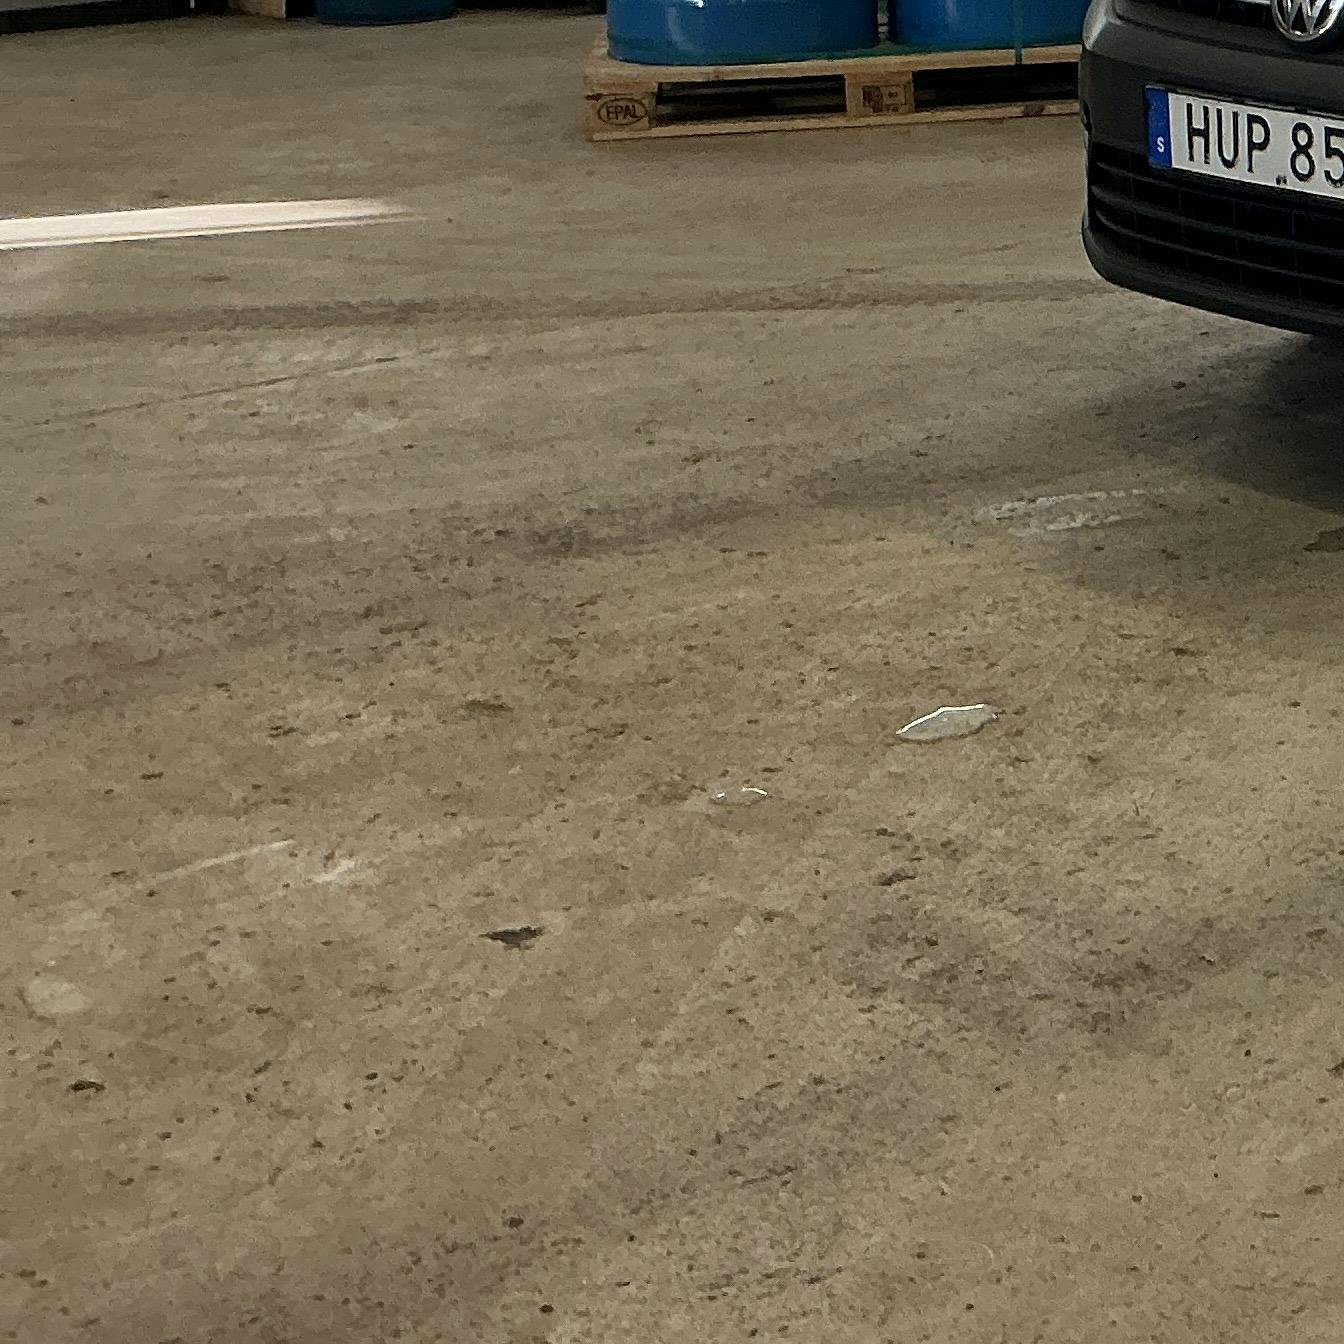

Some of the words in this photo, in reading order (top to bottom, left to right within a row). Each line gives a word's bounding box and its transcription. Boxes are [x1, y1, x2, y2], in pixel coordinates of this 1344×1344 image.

[606, 104, 640, 121] EPAL
[1156, 136, 1165, 153] S
[1186, 102, 1271, 174] HUP
